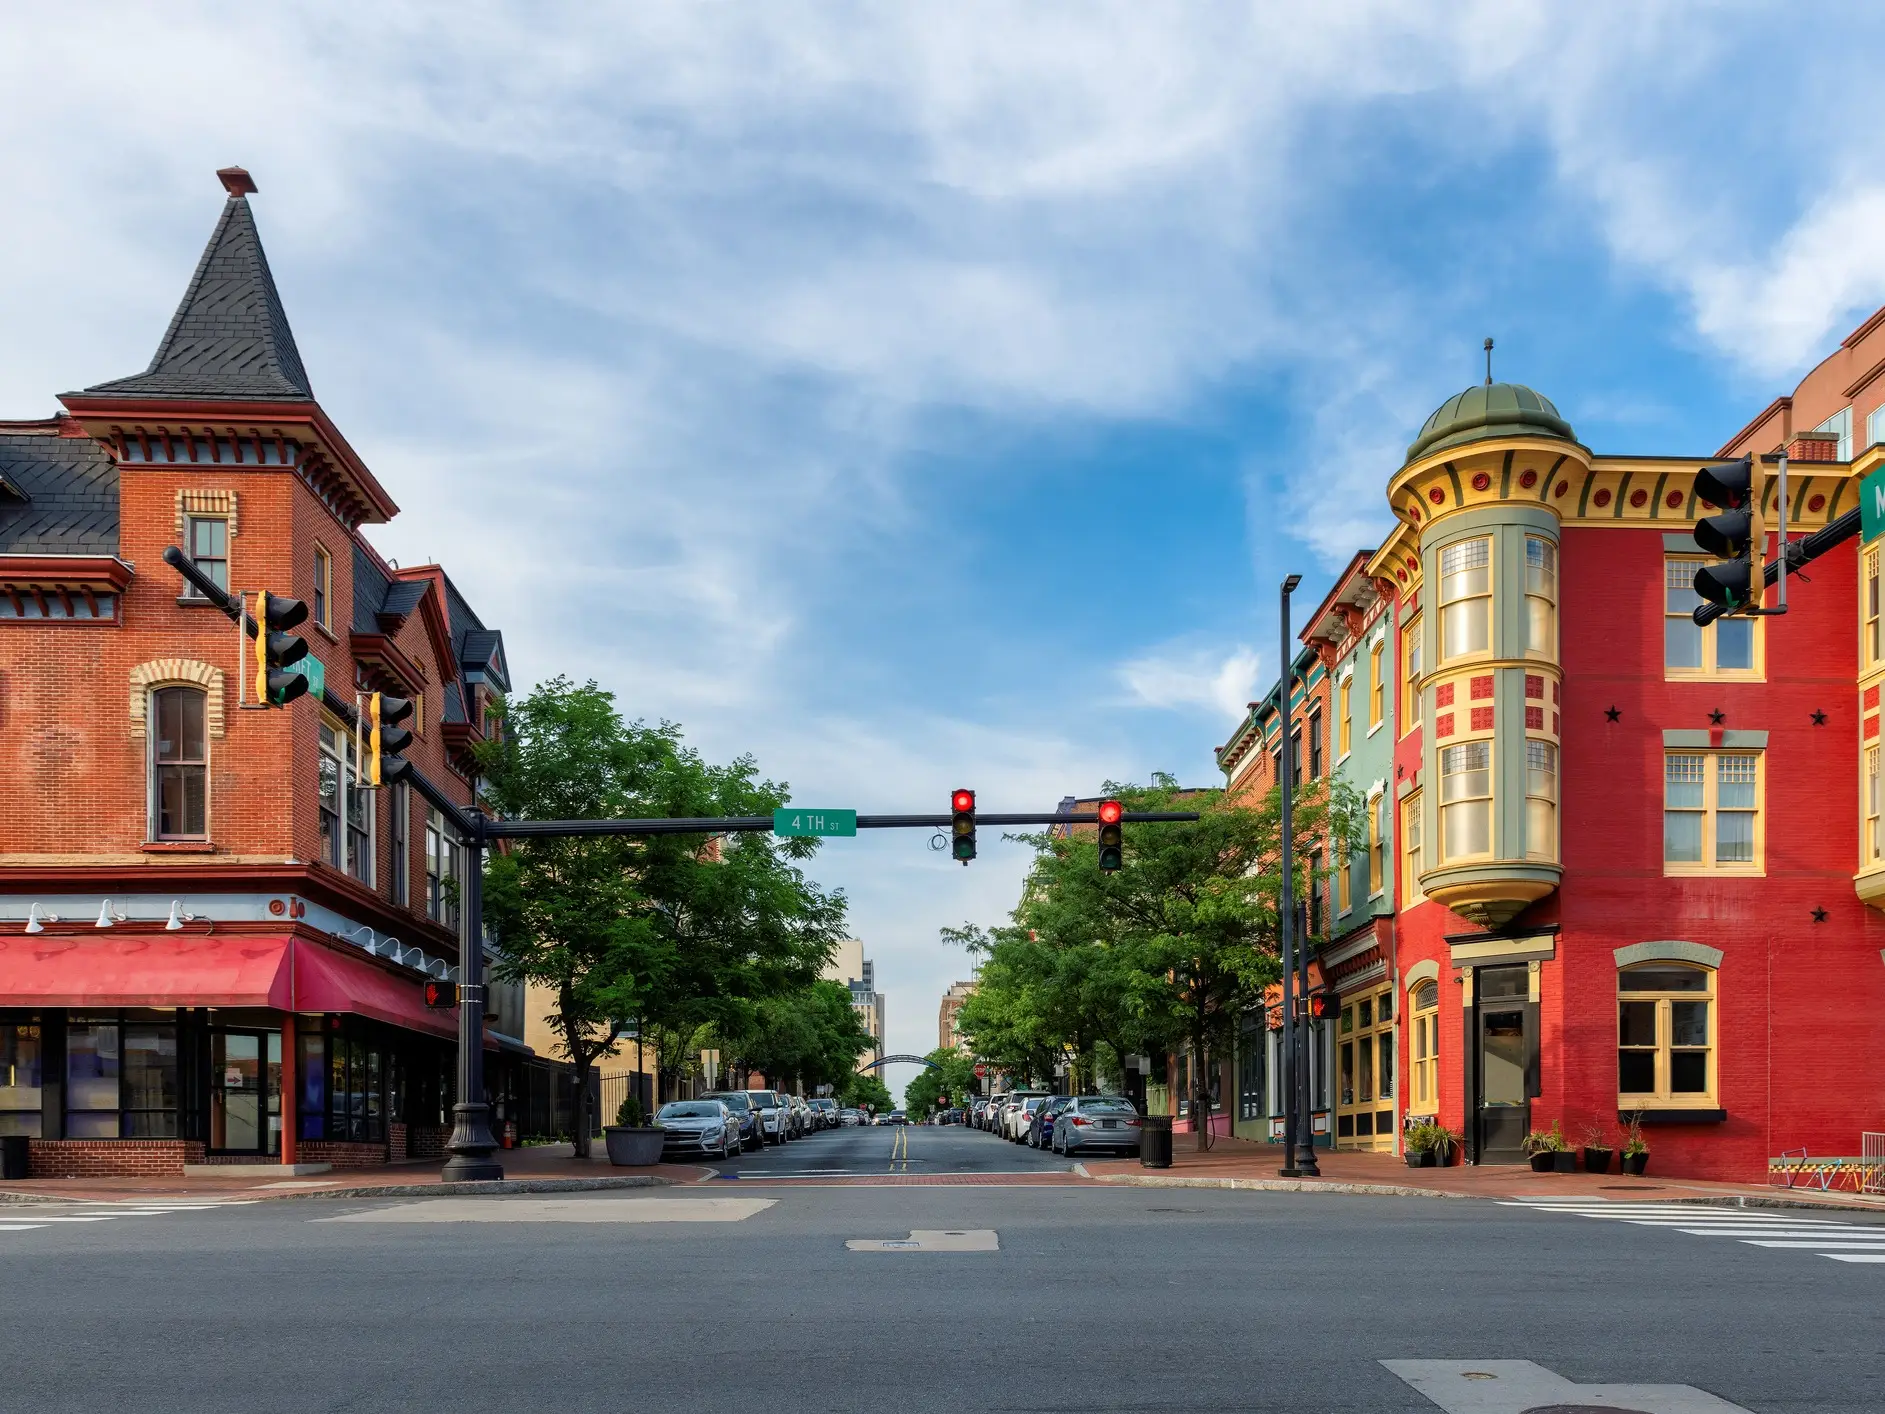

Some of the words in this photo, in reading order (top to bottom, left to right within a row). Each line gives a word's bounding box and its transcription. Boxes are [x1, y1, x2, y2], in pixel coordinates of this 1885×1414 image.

[792, 815, 801, 830] 4
[807, 815, 824, 830] TH
[830, 822, 840, 831] ST
